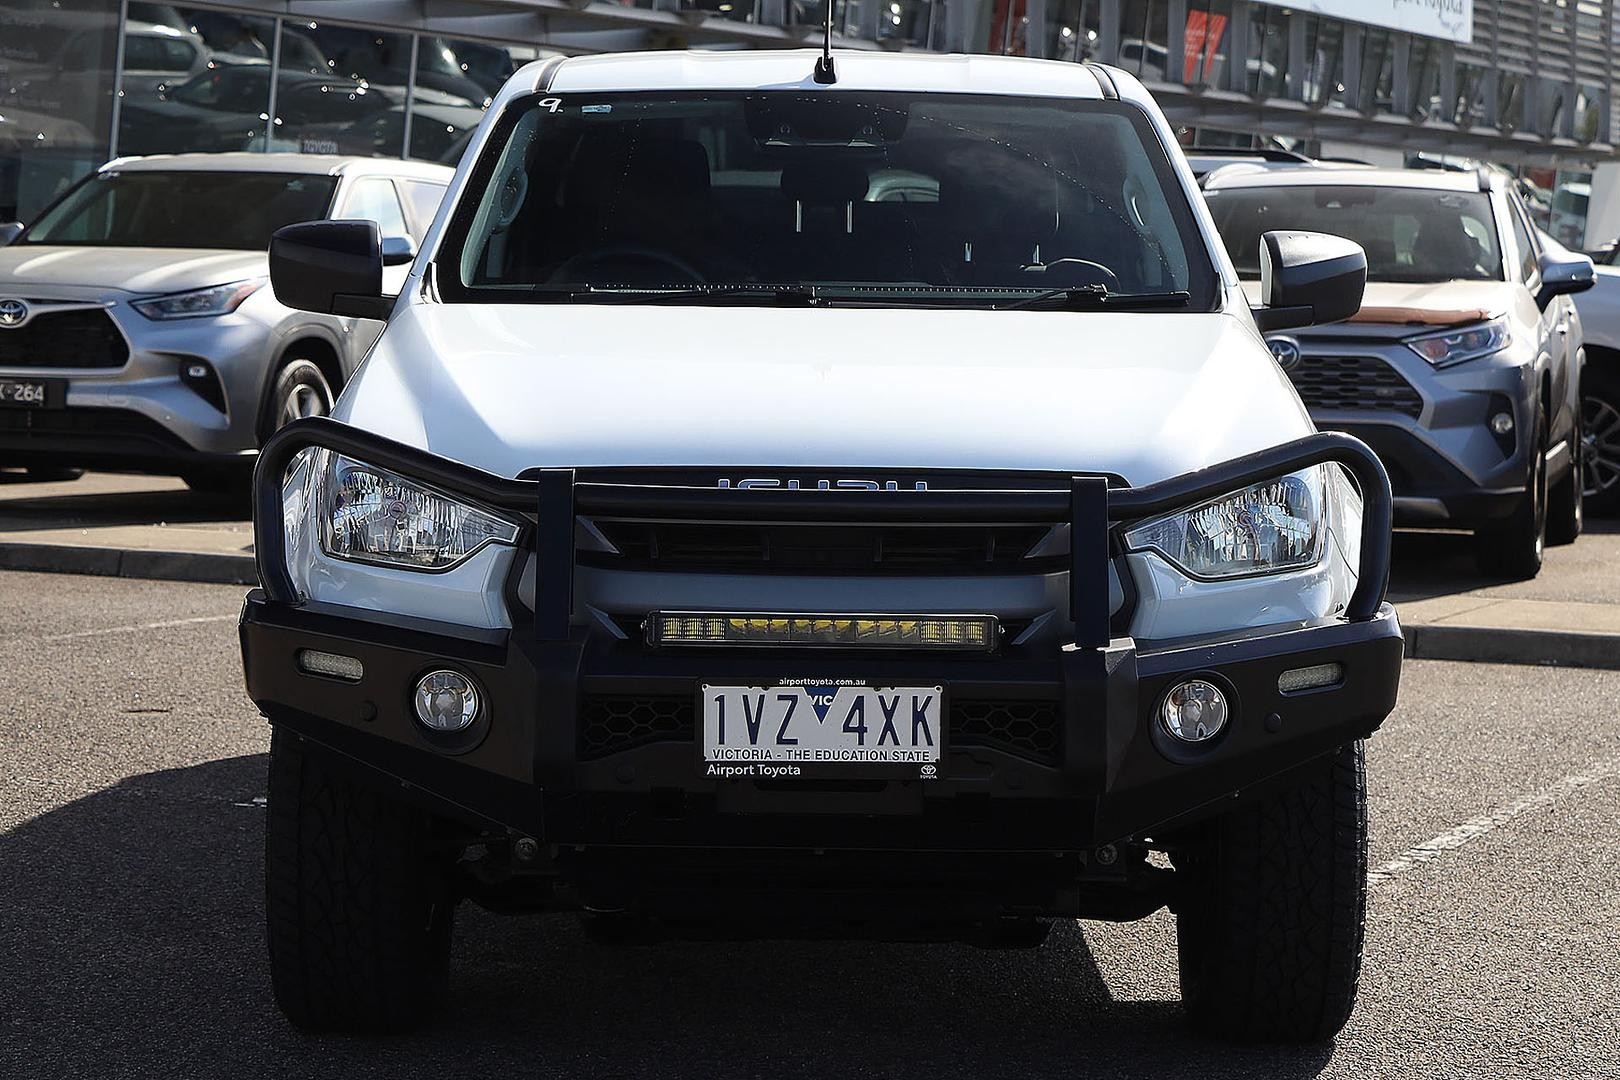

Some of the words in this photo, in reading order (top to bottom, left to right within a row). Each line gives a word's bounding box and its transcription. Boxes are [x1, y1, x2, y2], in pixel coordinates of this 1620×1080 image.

[779, 677, 866, 689] airporttoyota.com.au
[811, 695, 833, 706] VIC
[714, 694, 799, 746] 1VZ
[842, 695, 934, 747] 4XK
[712, 749, 773, 761] VICTORIA
[785, 749, 811, 761] THE
[815, 750, 888, 761] EDUCATION
[892, 751, 930, 761] STATE
[706, 764, 754, 778] Airport
[757, 764, 801, 778] Toyota
